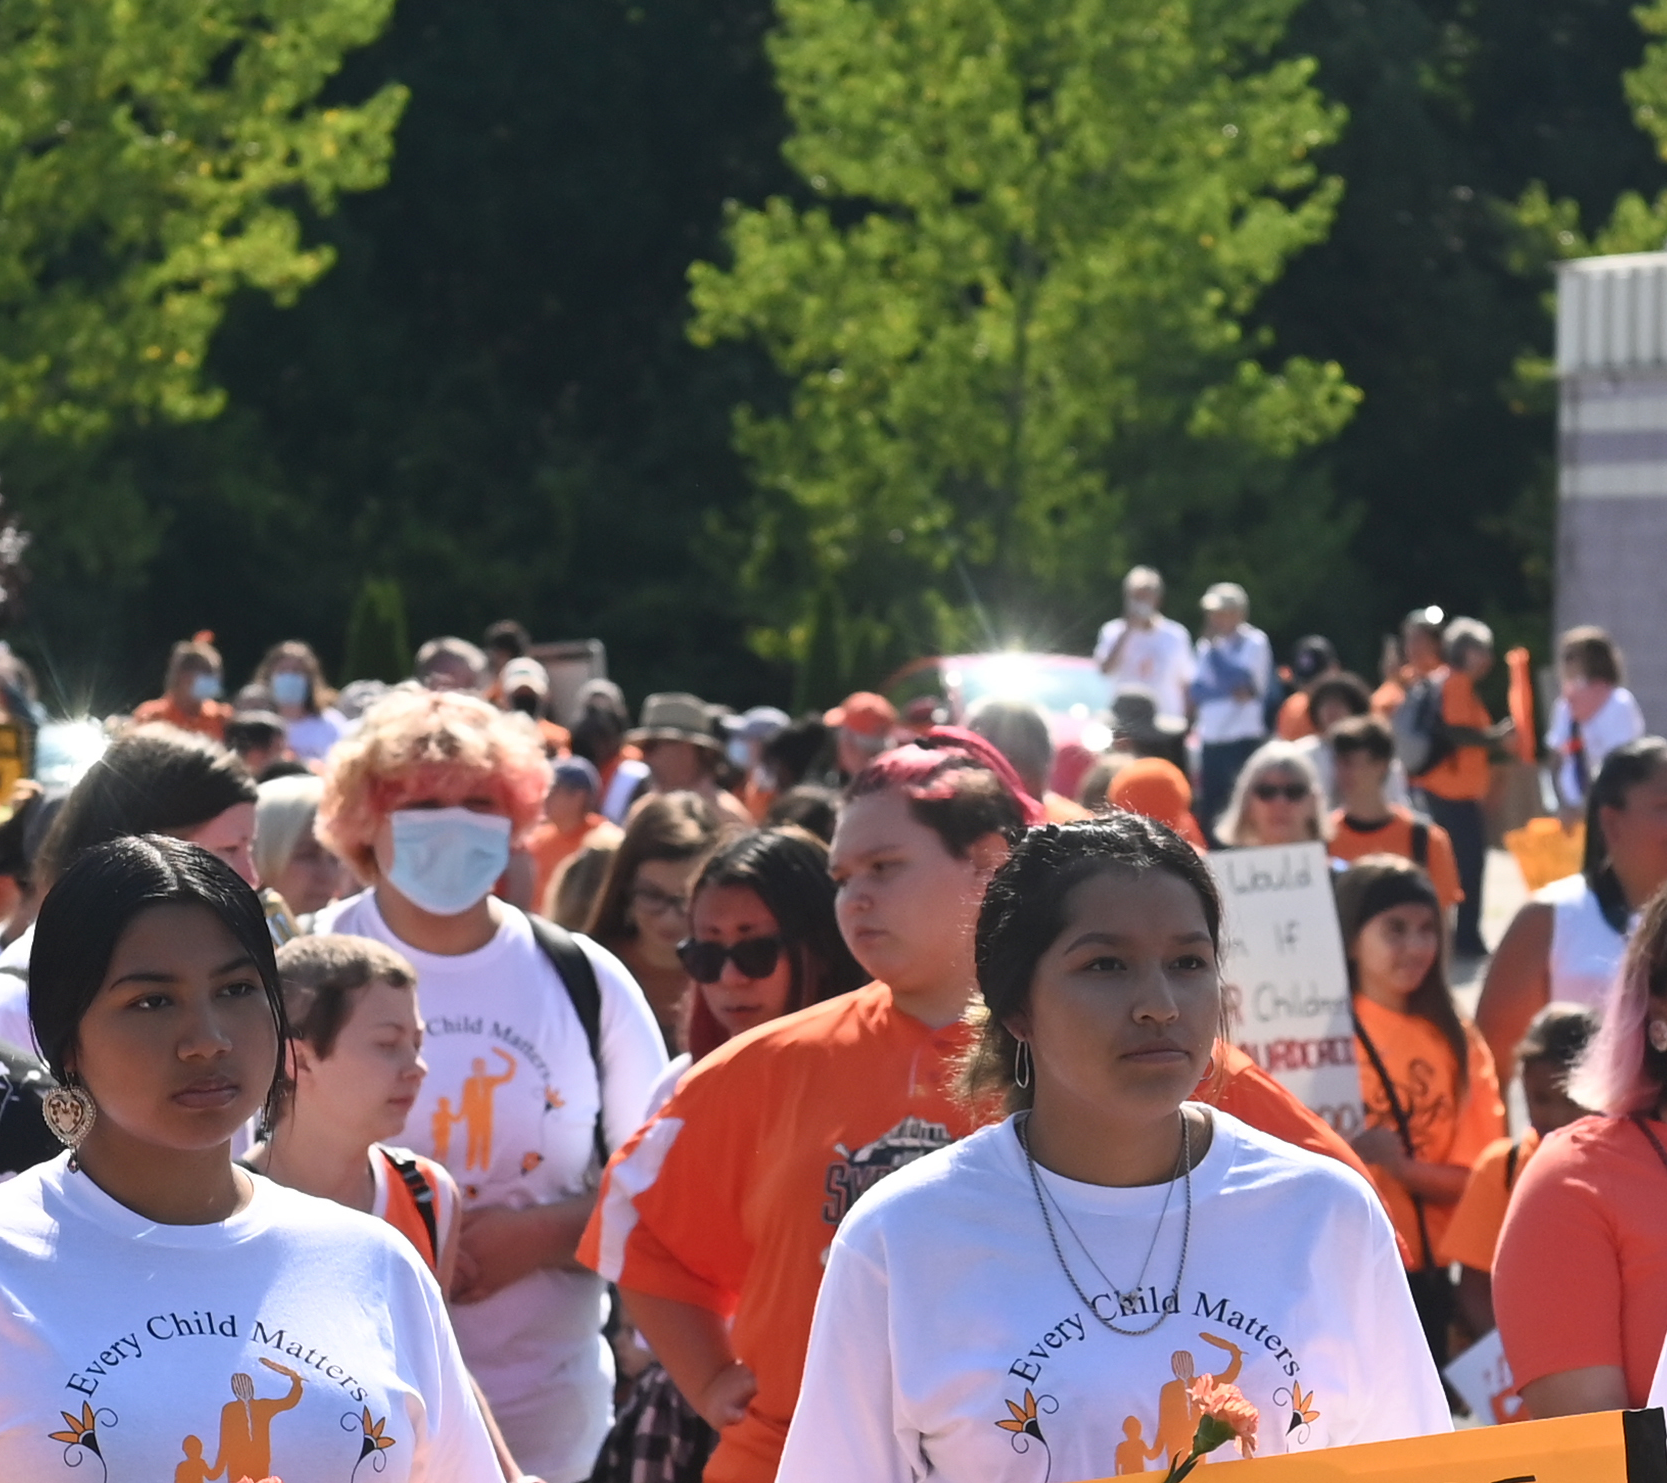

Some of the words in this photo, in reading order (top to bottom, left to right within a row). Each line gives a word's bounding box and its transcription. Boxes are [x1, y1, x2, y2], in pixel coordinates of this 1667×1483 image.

[426, 1015, 484, 1037] Child
[490, 1020, 551, 1081] Matters
[66, 1331, 143, 1399] Every
[146, 1311, 239, 1341] Child
[250, 1320, 369, 1403] Matters
[1007, 1312, 1086, 1386] Every
[1091, 1286, 1181, 1322] Child
[1192, 1291, 1301, 1378] Matters
